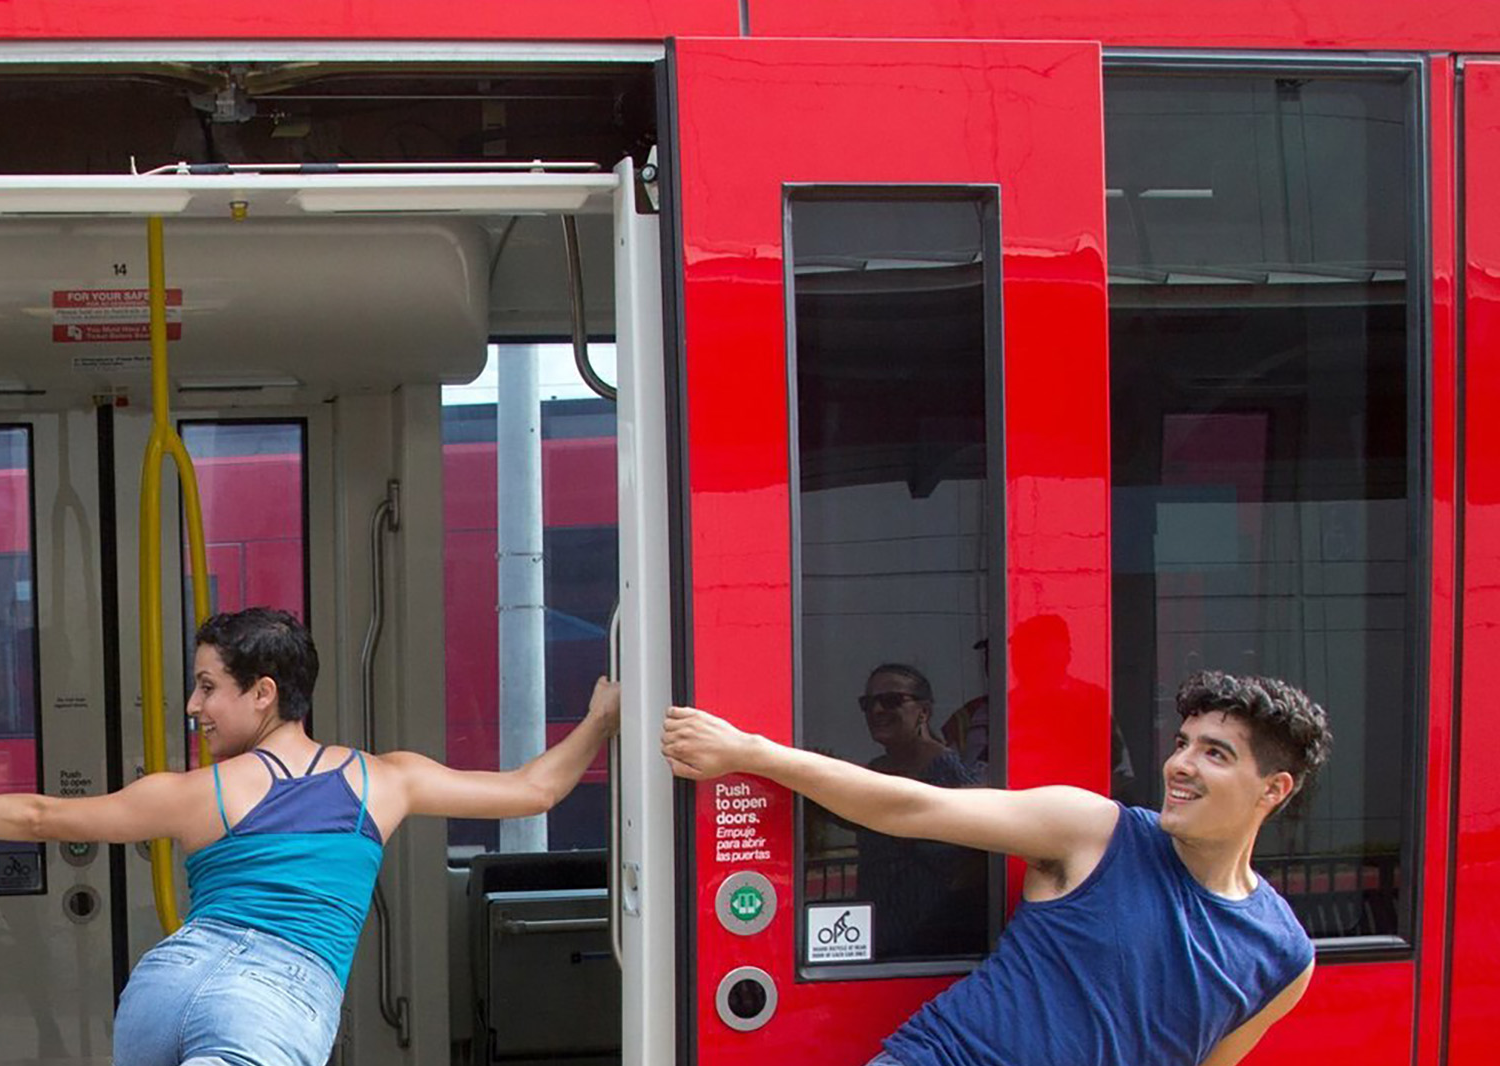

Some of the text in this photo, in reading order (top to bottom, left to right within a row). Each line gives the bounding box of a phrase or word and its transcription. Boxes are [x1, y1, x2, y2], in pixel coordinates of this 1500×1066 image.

[113, 263, 128, 276] 14
[67, 292, 90, 302] FOR
[92, 291, 122, 301] YOUR
[60, 770, 82, 779] Push
[70, 779, 92, 788] open
[716, 782, 750, 796] Push
[716, 797, 767, 812] to open
[716, 811, 760, 825] doors.
[716, 826, 756, 839] Empuje
[716, 837, 766, 852] para abrir
[716, 849, 770, 863] las puertas
